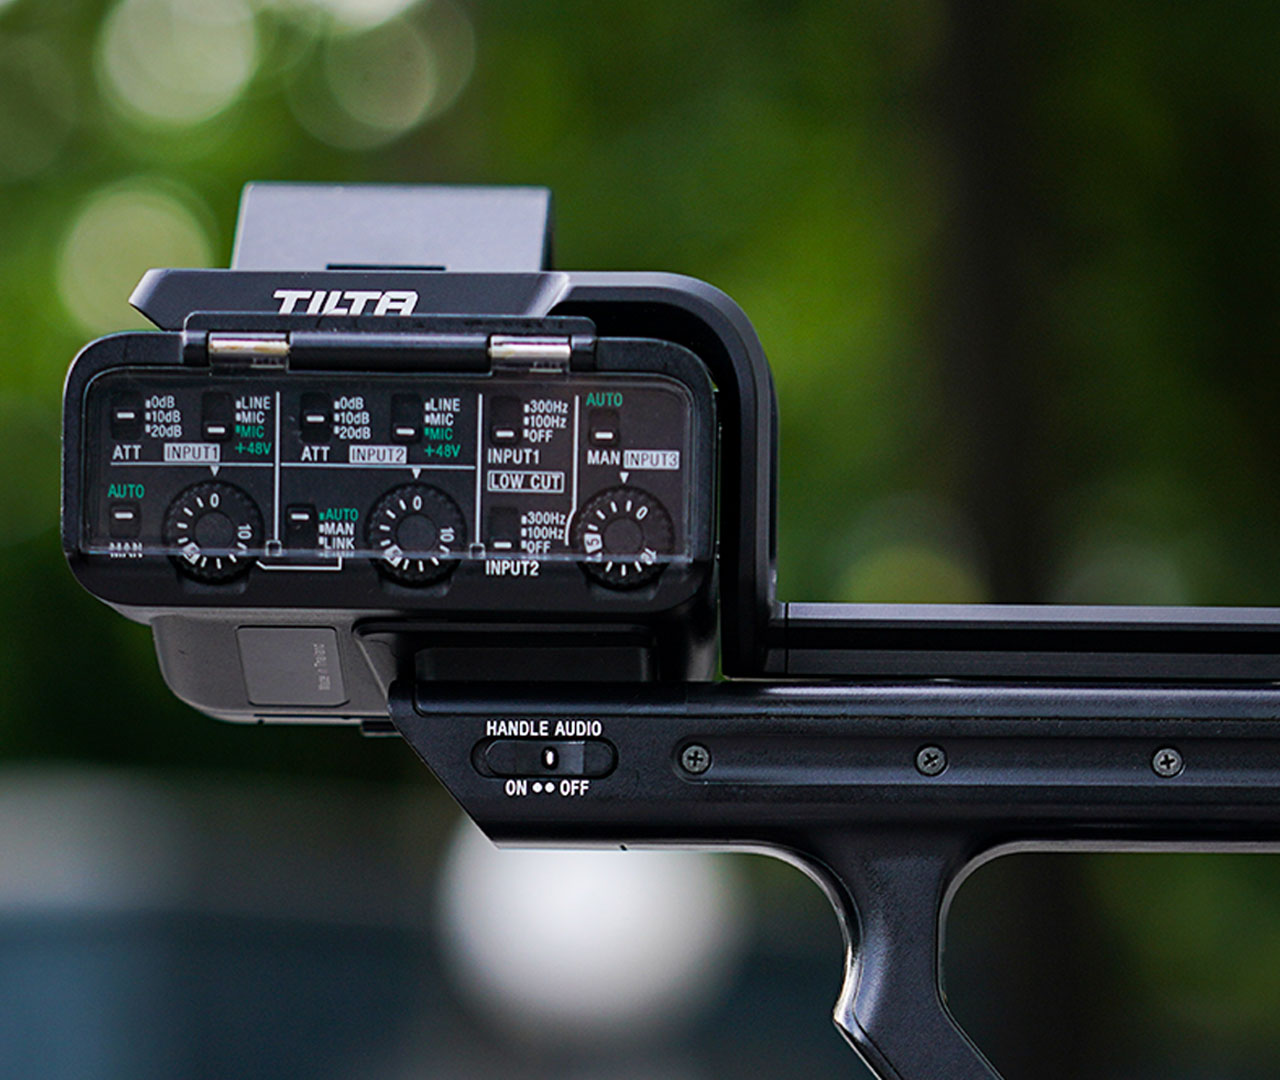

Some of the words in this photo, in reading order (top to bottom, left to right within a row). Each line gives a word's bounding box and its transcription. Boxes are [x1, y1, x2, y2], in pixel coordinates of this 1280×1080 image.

[273, 289, 419, 316] TILTA
[151, 397, 175, 409] 0dB
[241, 398, 270, 410] LINE
[340, 398, 364, 410] 0dB
[430, 399, 460, 412] LINE
[586, 393, 623, 406] AUTO
[529, 400, 568, 413] 300Hz
[151, 410, 181, 422] 10dB
[241, 411, 265, 423] MIC
[340, 412, 370, 424] 10dB
[430, 413, 454, 426] MIC
[529, 415, 566, 428] 100Hz
[151, 425, 182, 438] 20dB
[241, 426, 265, 439] MIC
[340, 426, 371, 439] 20dB
[430, 427, 453, 440] MIC
[529, 429, 553, 442] OFF
[113, 445, 141, 460] ATT
[166, 445, 219, 460] INPUT1
[235, 442, 271, 455] +48V
[301, 446, 330, 461] ATT
[351, 448, 404, 462] INPUT2
[425, 444, 461, 457] +48V
[488, 449, 540, 464] INPUT1
[587, 451, 620, 465] MAN
[625, 452, 678, 467] INPUT3
[491, 474, 523, 489] LOW
[531, 475, 561, 490] CUT
[108, 485, 145, 498] AUTO
[325, 508, 359, 521] AUTO
[527, 512, 566, 525] 300Hz
[237, 523, 252, 540] 10
[325, 523, 355, 535] MAN
[439, 527, 455, 543] 10
[527, 527, 564, 540] 100Hz
[324, 537, 355, 549] LINK
[527, 541, 551, 553] OFF
[485, 560, 540, 576] INPUT2
[486, 721, 549, 737] HANDLE
[554, 721, 602, 737] AUDIO
[505, 780, 528, 796] ON
[559, 781, 589, 796] OFF
